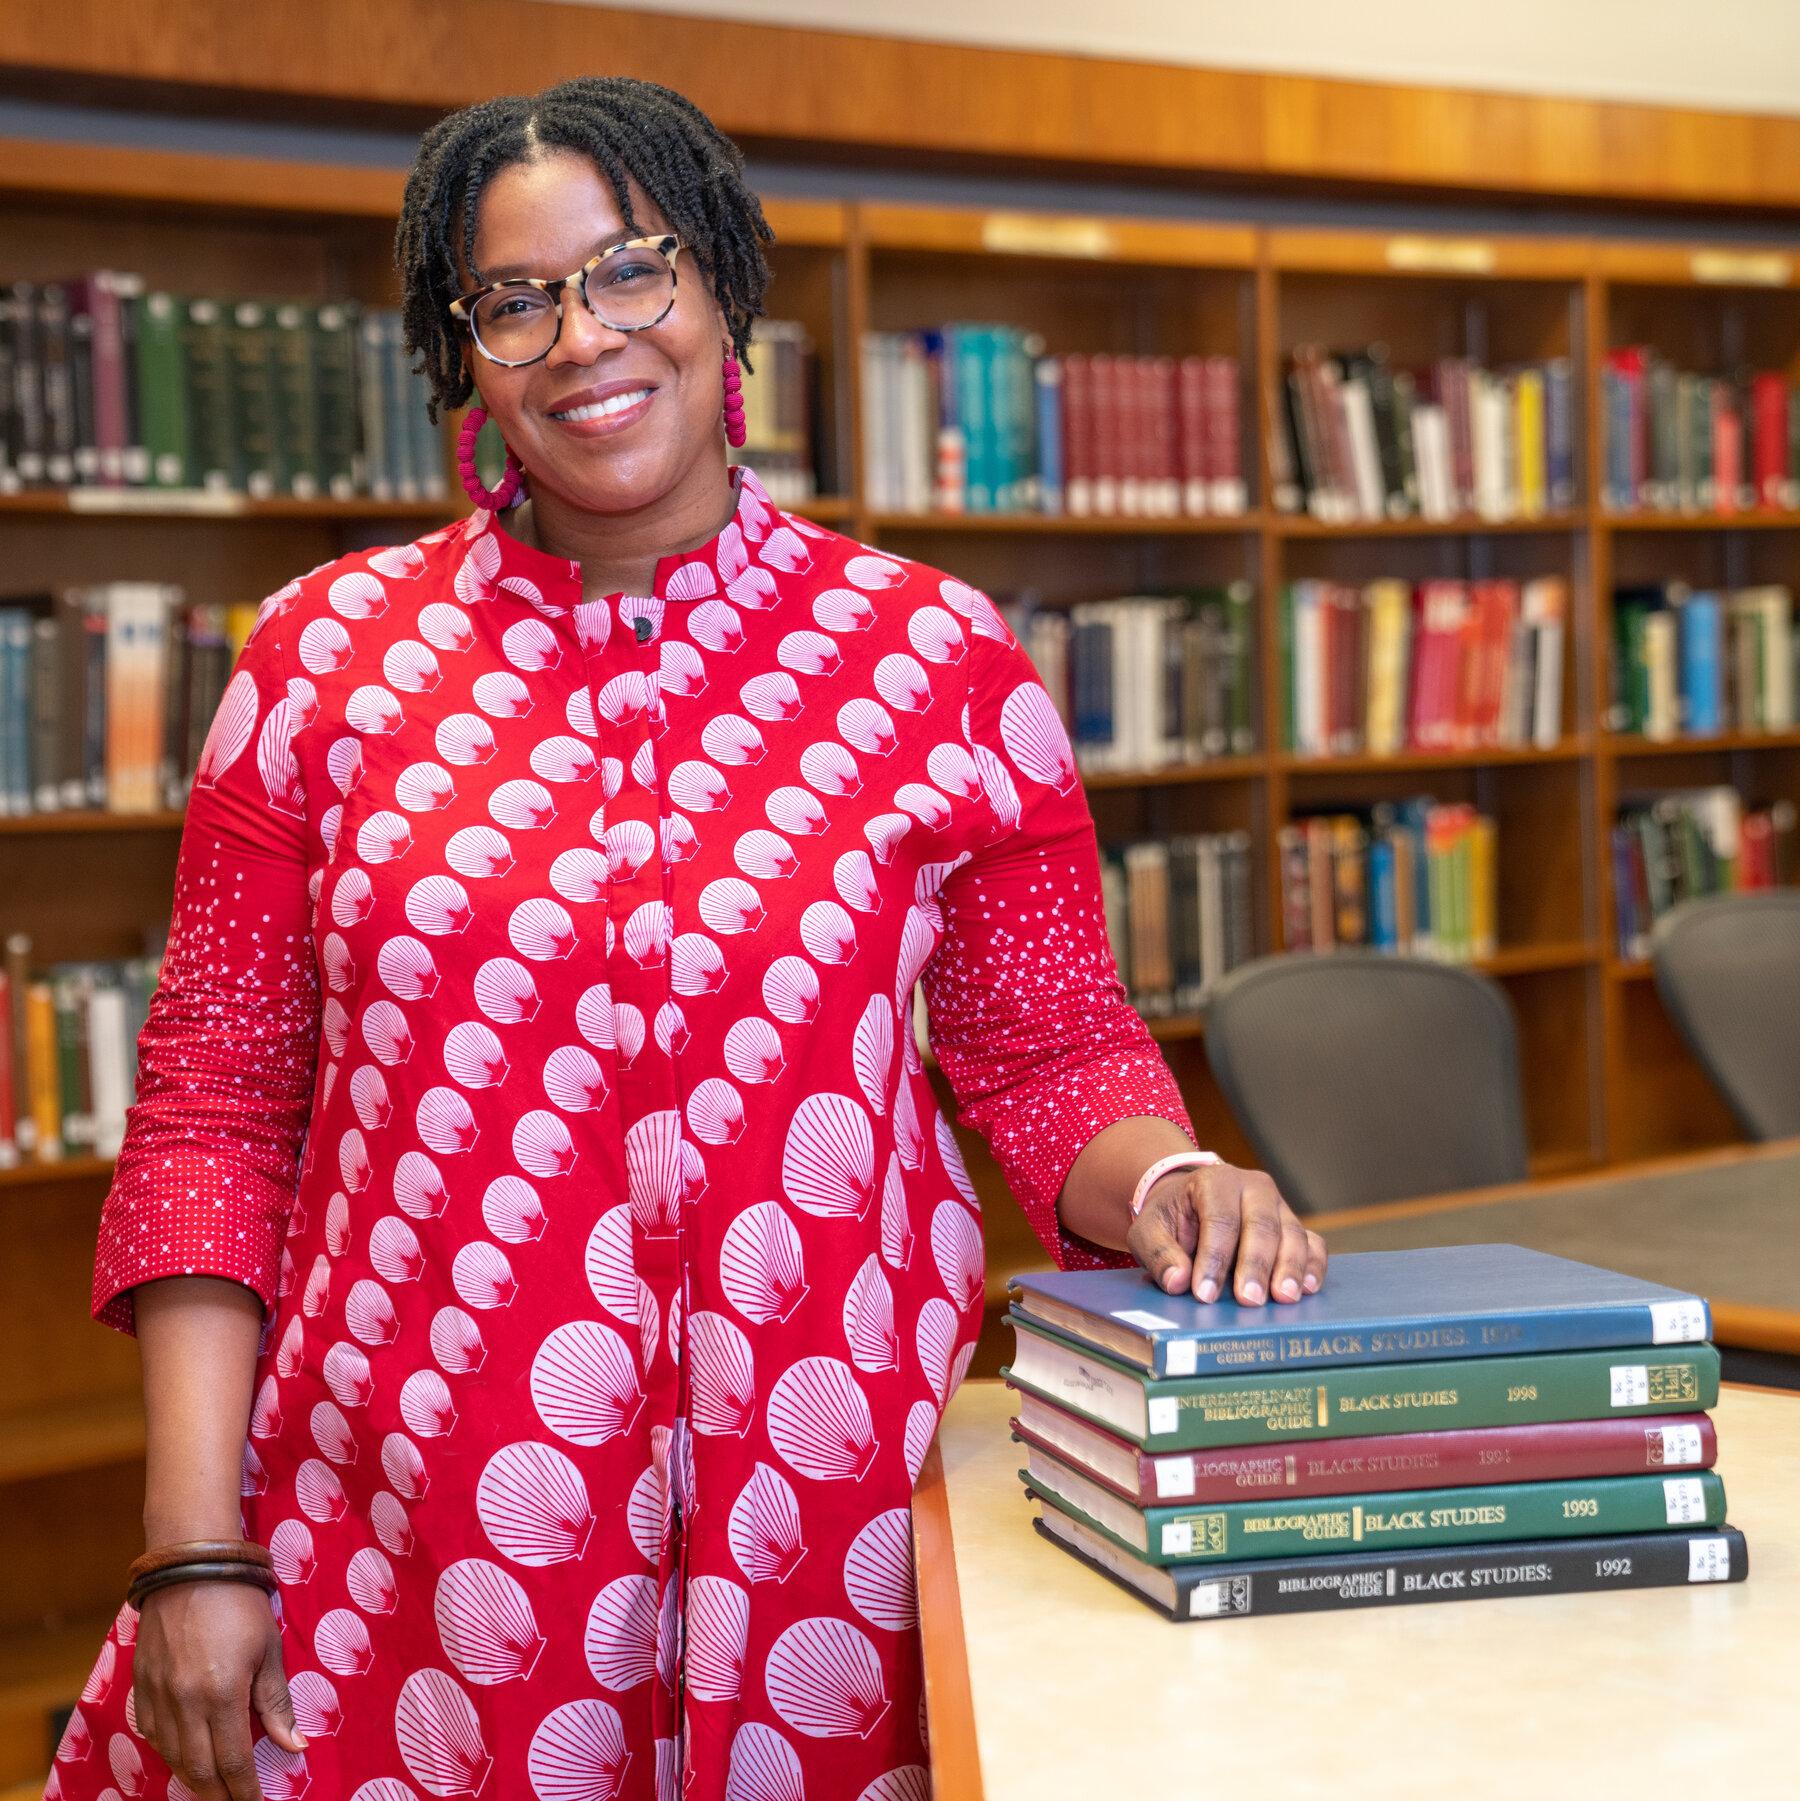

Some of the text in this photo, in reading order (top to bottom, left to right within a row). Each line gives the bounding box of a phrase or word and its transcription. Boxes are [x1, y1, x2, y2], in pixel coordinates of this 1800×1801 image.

[1217, 1350, 1275, 1365] GUIDE TO
[1289, 1336, 1363, 1358] BLACK
[1179, 1387, 1312, 1409] NTERDISCIPLINARY
[1339, 1385, 1538, 1412] BLACK STUDIES 1998
[1204, 1401, 1312, 1421] BIBLIOGRAPHIC
[1267, 1416, 1313, 1430] GUIDE
[1307, 1458, 1363, 1477] BLACK
[1368, 1453, 1439, 1473] STUDIES
[1236, 1473, 1282, 1487] GUIDE
[1243, 1513, 1349, 1533] BIBLIOGRAPHIC
[1365, 1499, 1598, 1532] BLACK STUDIES 1993
[1303, 1525, 1349, 1541] GUIDE
[1278, 1571, 1382, 1593] BIBLIOGRAPHIC
[1403, 1558, 1632, 1592] BLACK STUDIES: 1992
[1339, 1584, 1382, 1599] GUIDE
